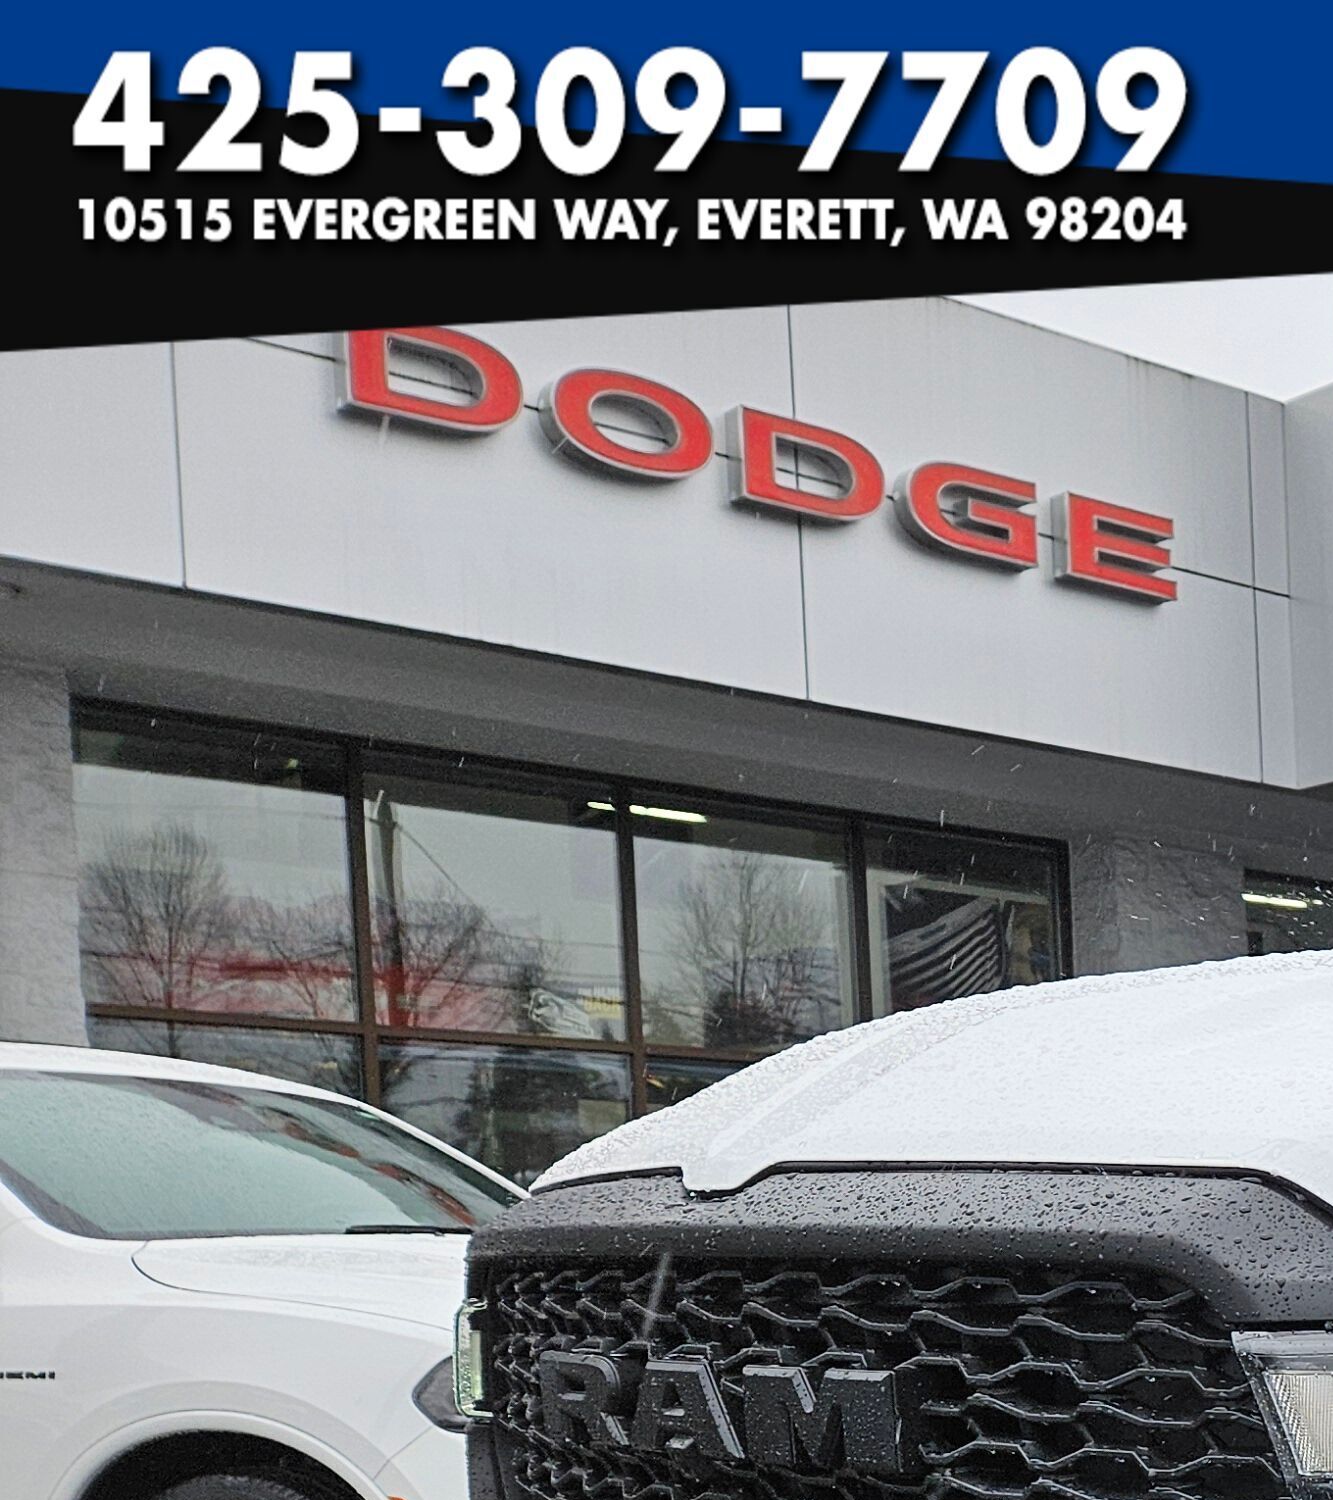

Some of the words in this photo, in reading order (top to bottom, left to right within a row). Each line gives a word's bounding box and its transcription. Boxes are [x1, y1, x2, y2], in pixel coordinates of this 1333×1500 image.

[340, 324, 1178, 604] DODGE
[0, 1371, 56, 1380] EMI
[539, 1346, 903, 1474] RAM
